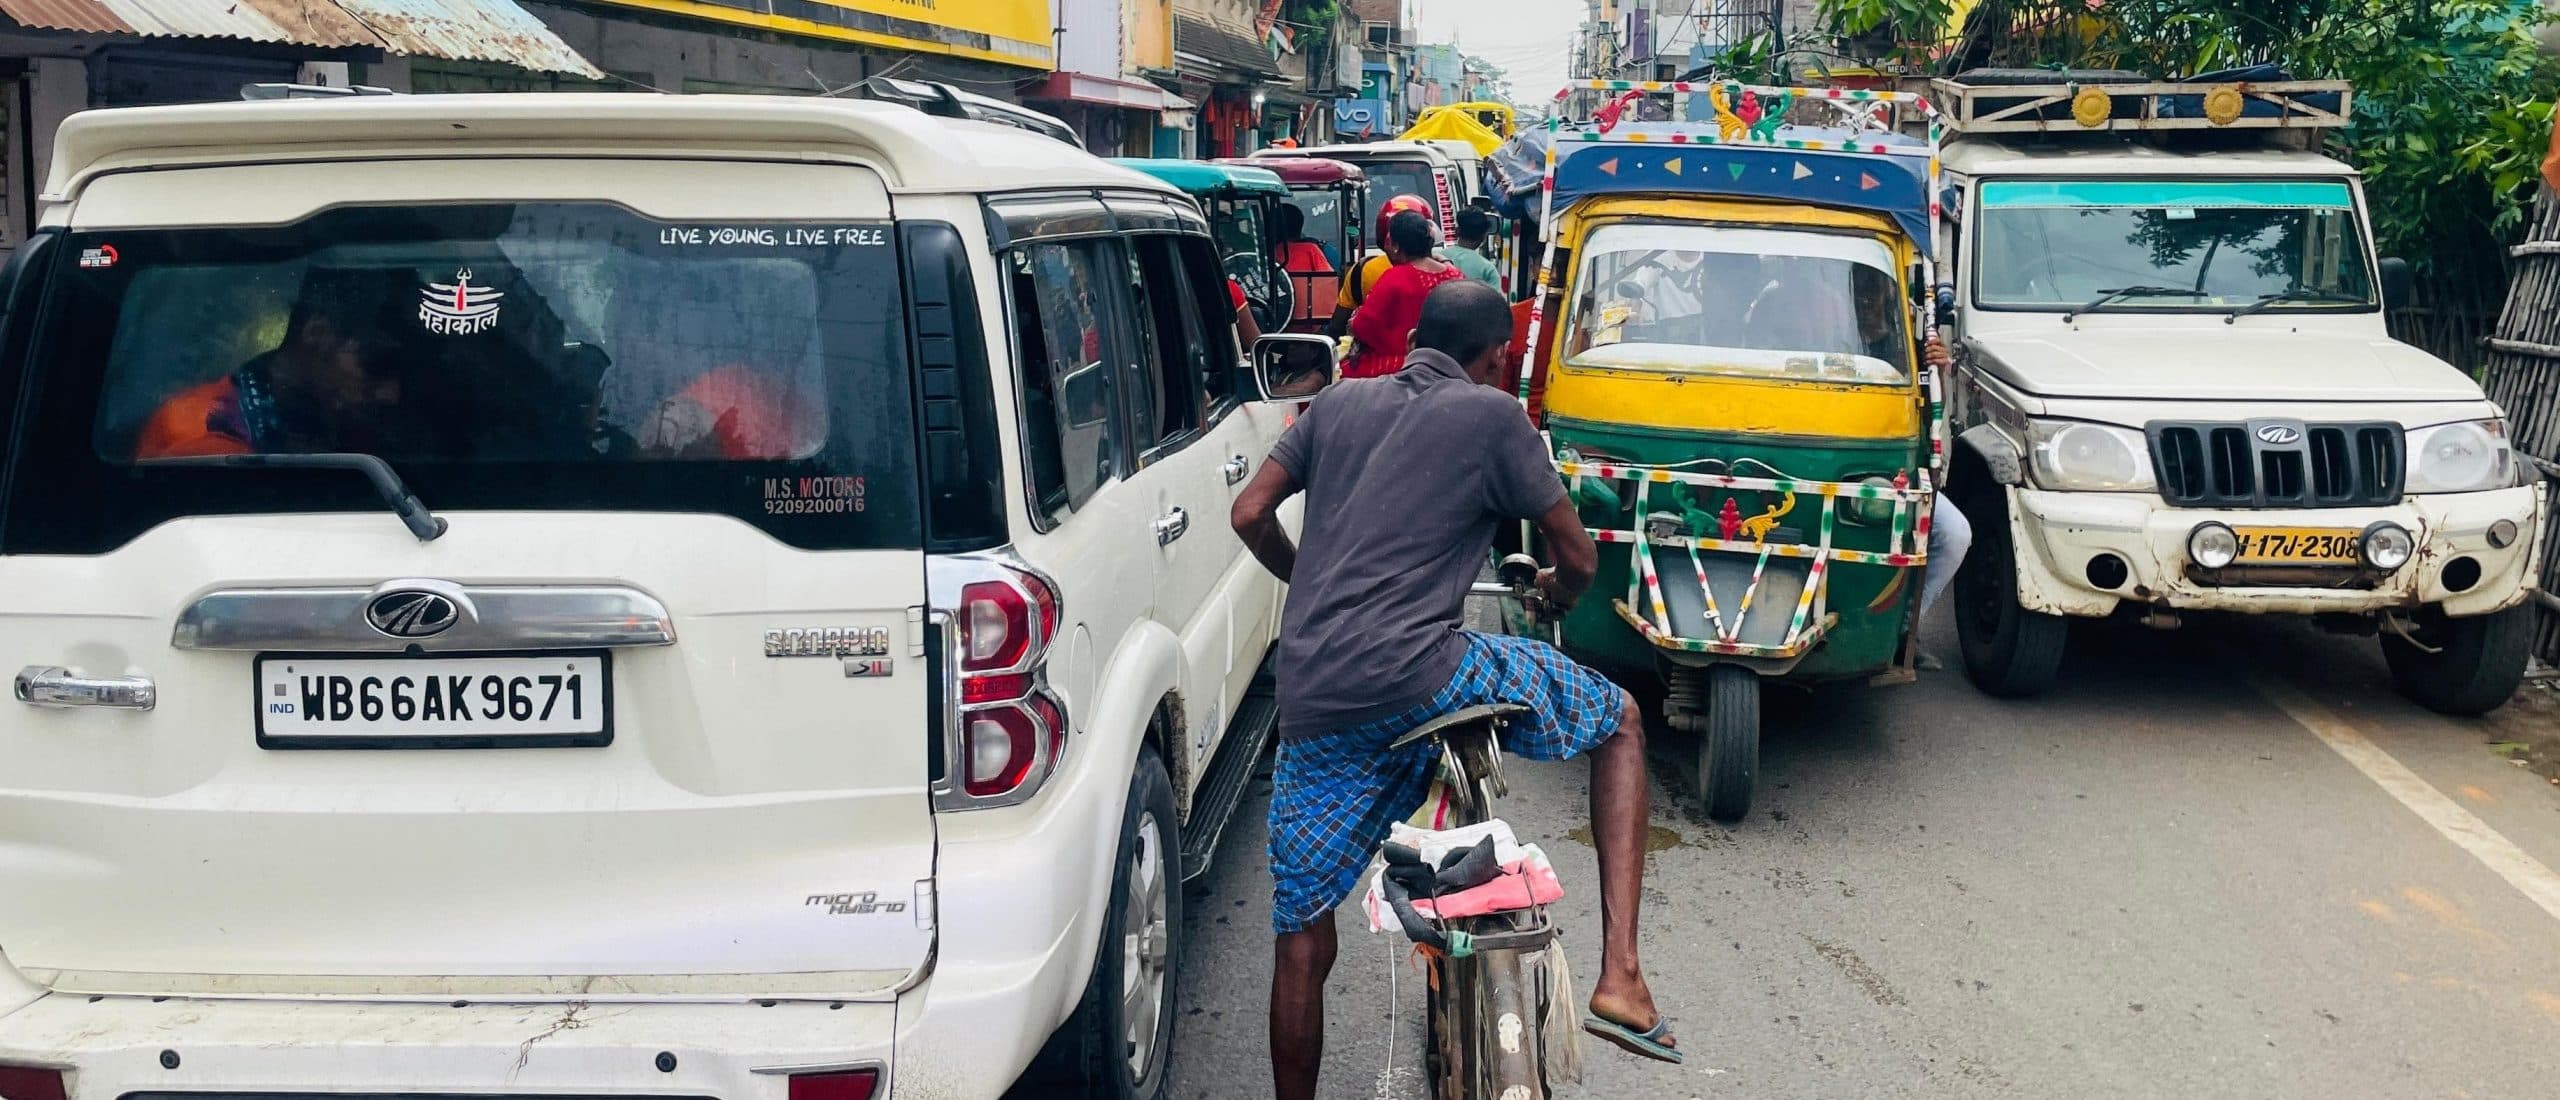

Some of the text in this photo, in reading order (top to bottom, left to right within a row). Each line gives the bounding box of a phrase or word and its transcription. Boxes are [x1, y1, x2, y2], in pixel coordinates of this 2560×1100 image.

[660, 228, 885, 247] LIVE YOUNG, LIVE FREE
[418, 303, 500, 336] महाकाल
[764, 476, 865, 499] M.S. MOTORS
[764, 498, 865, 515] 9209200016
[269, 703, 295, 714] IND
[300, 674, 582, 722] WB66AK9671
